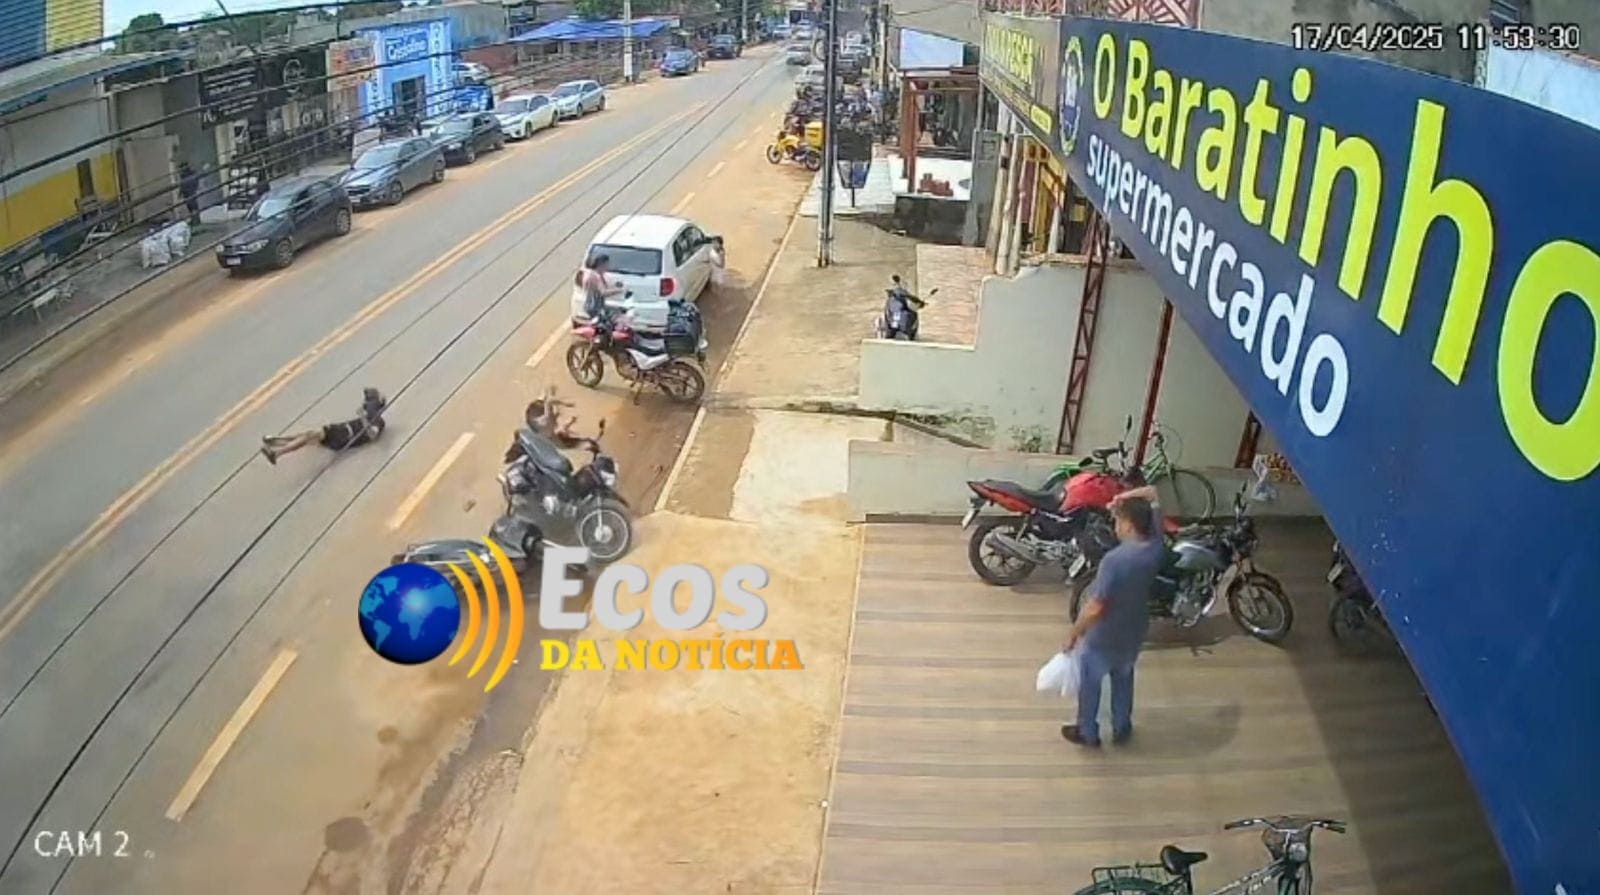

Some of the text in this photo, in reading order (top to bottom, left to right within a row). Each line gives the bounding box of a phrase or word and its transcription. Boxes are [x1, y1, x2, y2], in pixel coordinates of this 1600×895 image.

[1085, 132, 1350, 437] supermercado
[1093, 33, 1600, 482] O Baratinho
